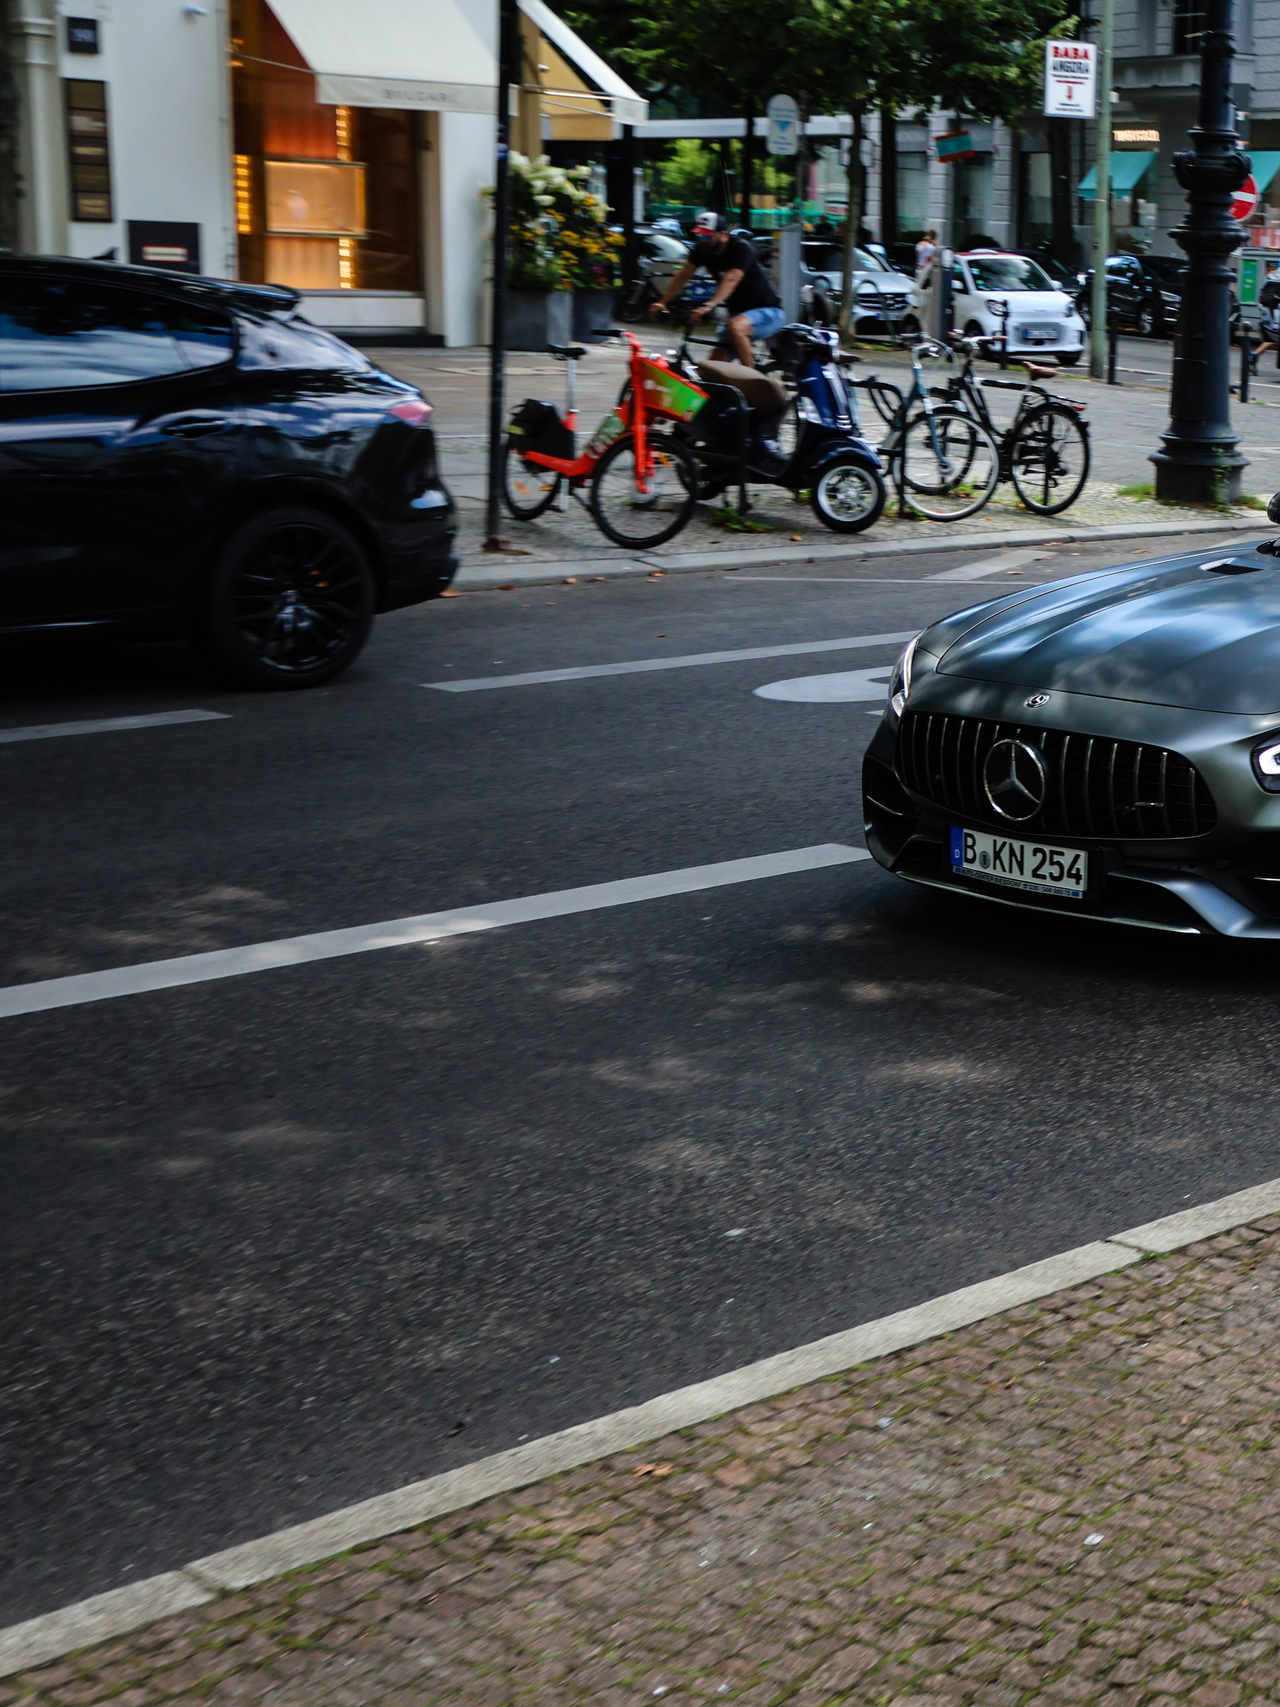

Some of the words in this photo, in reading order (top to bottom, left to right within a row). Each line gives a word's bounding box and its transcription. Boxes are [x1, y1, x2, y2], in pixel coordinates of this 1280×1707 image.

[1052, 46, 1090, 60] BABA
[963, 832, 977, 865] B
[993, 838, 1025, 877] KN
[1031, 846, 1083, 886] 254
